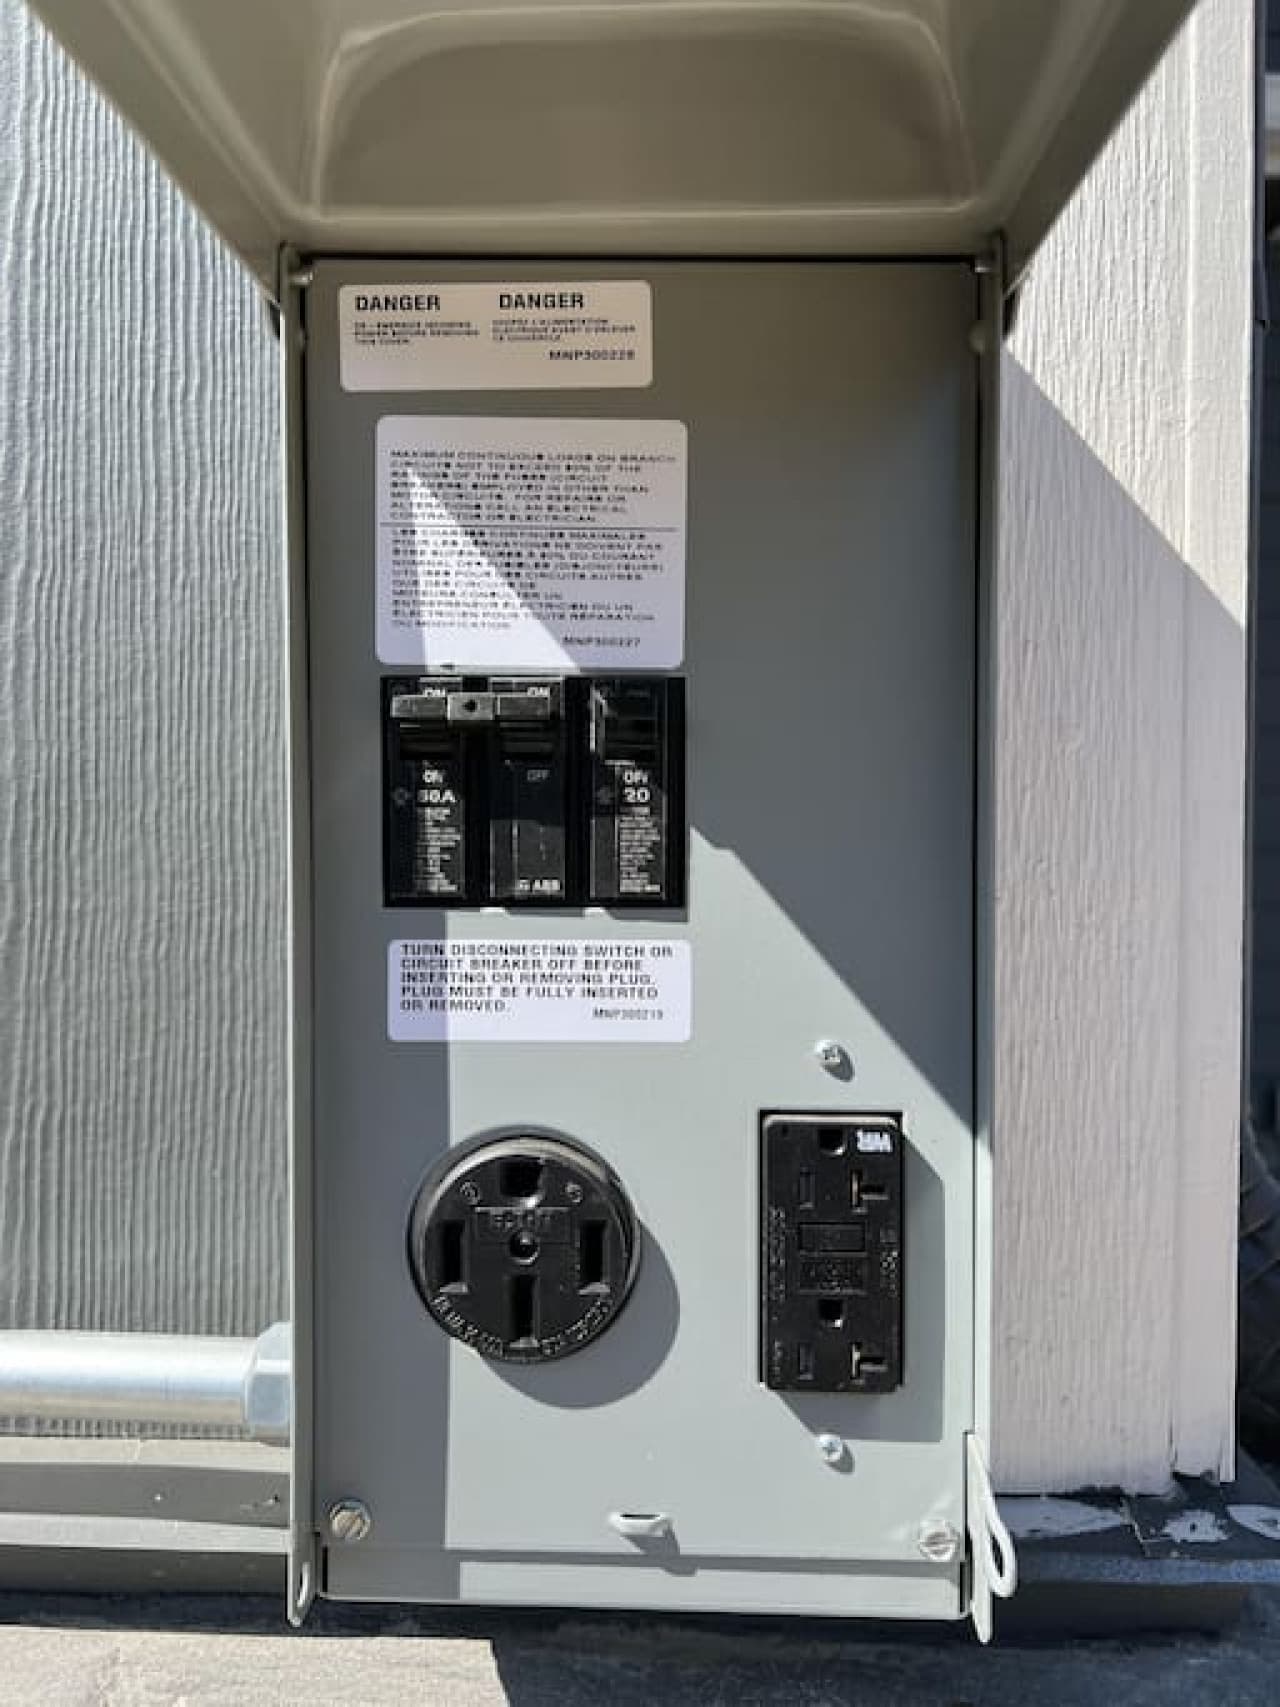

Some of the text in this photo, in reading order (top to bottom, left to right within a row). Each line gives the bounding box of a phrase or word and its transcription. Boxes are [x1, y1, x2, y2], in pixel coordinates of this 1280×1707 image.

[355, 294, 440, 311] DANGER
[499, 293, 584, 309] DANGER
[400, 945, 673, 957] TURN DISCONNECTING SWITCH OR
[400, 960, 643, 970] CIRCUIT BREAKER OFF BEFORE
[401, 972, 486, 982] INSERTING
[491, 973, 514, 983] OR
[519, 973, 603, 984] REMOVING
[401, 986, 658, 998] PLUG MUST BE FULLY INSERTED
[400, 1000, 423, 1011] OR
